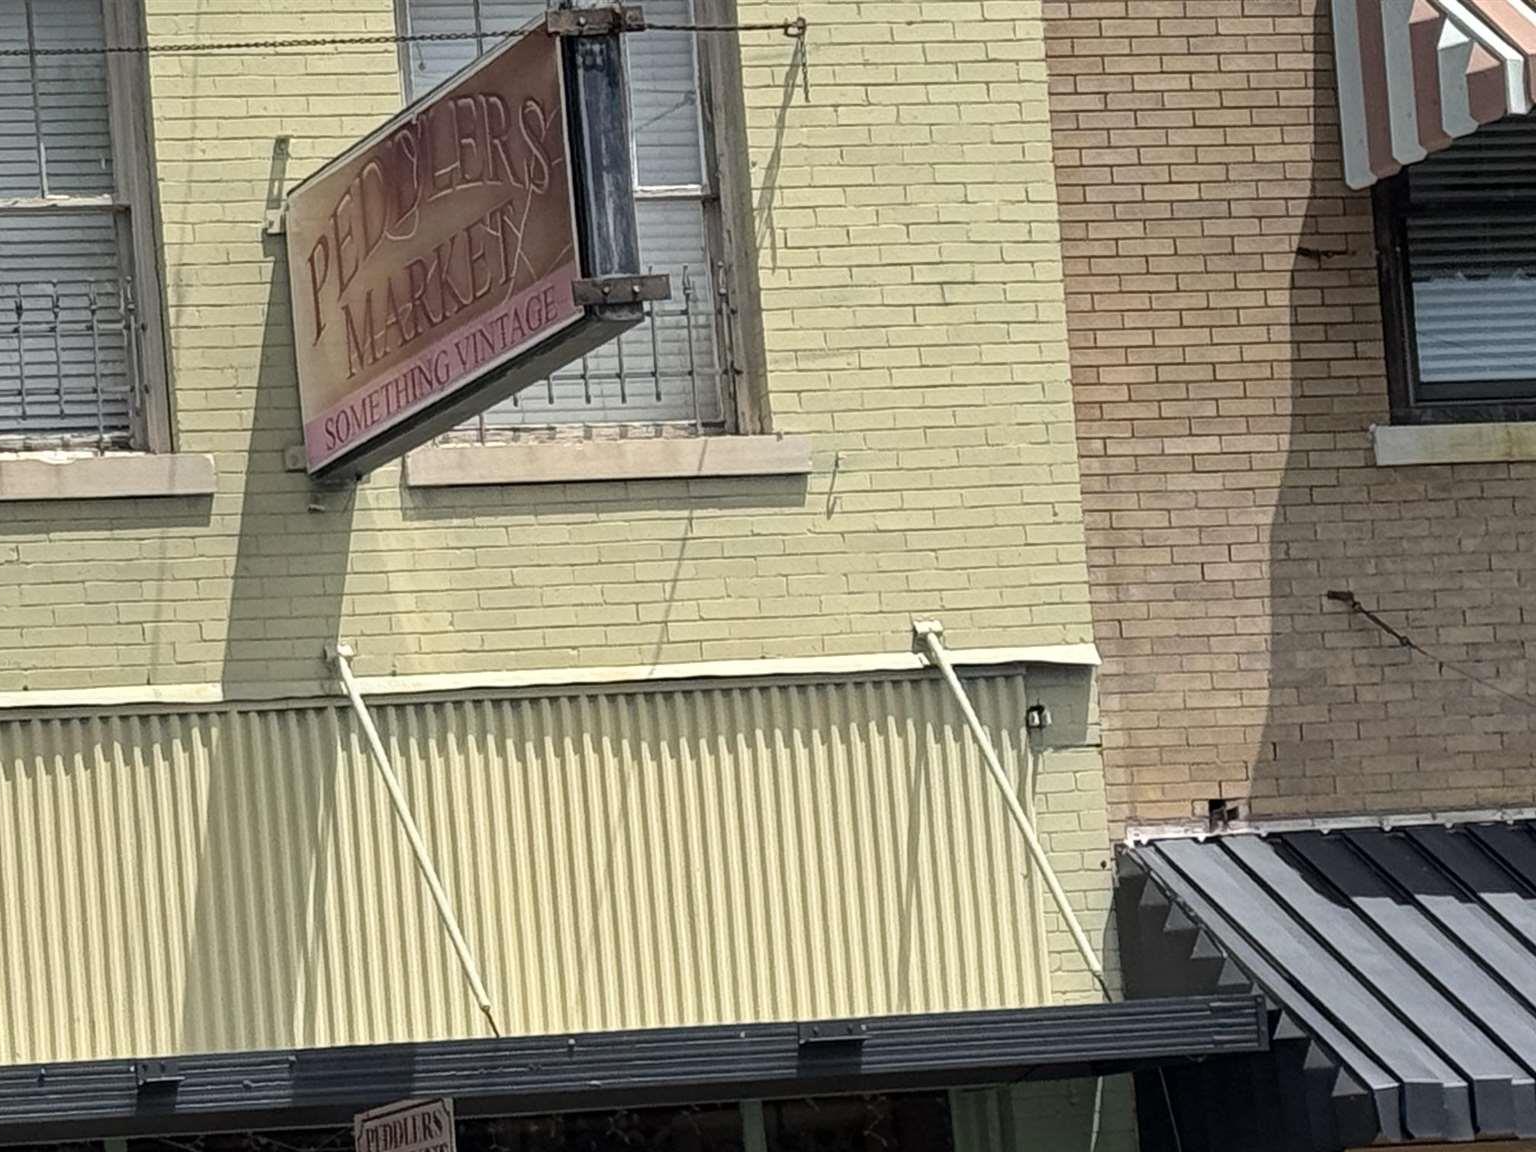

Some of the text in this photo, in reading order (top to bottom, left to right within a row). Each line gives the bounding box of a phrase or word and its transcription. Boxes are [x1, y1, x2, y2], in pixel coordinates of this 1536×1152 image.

[306, 92, 552, 347] PEDDLERS
[341, 199, 517, 379] MARKET
[323, 286, 559, 451] SOMETHING VINTAGE
